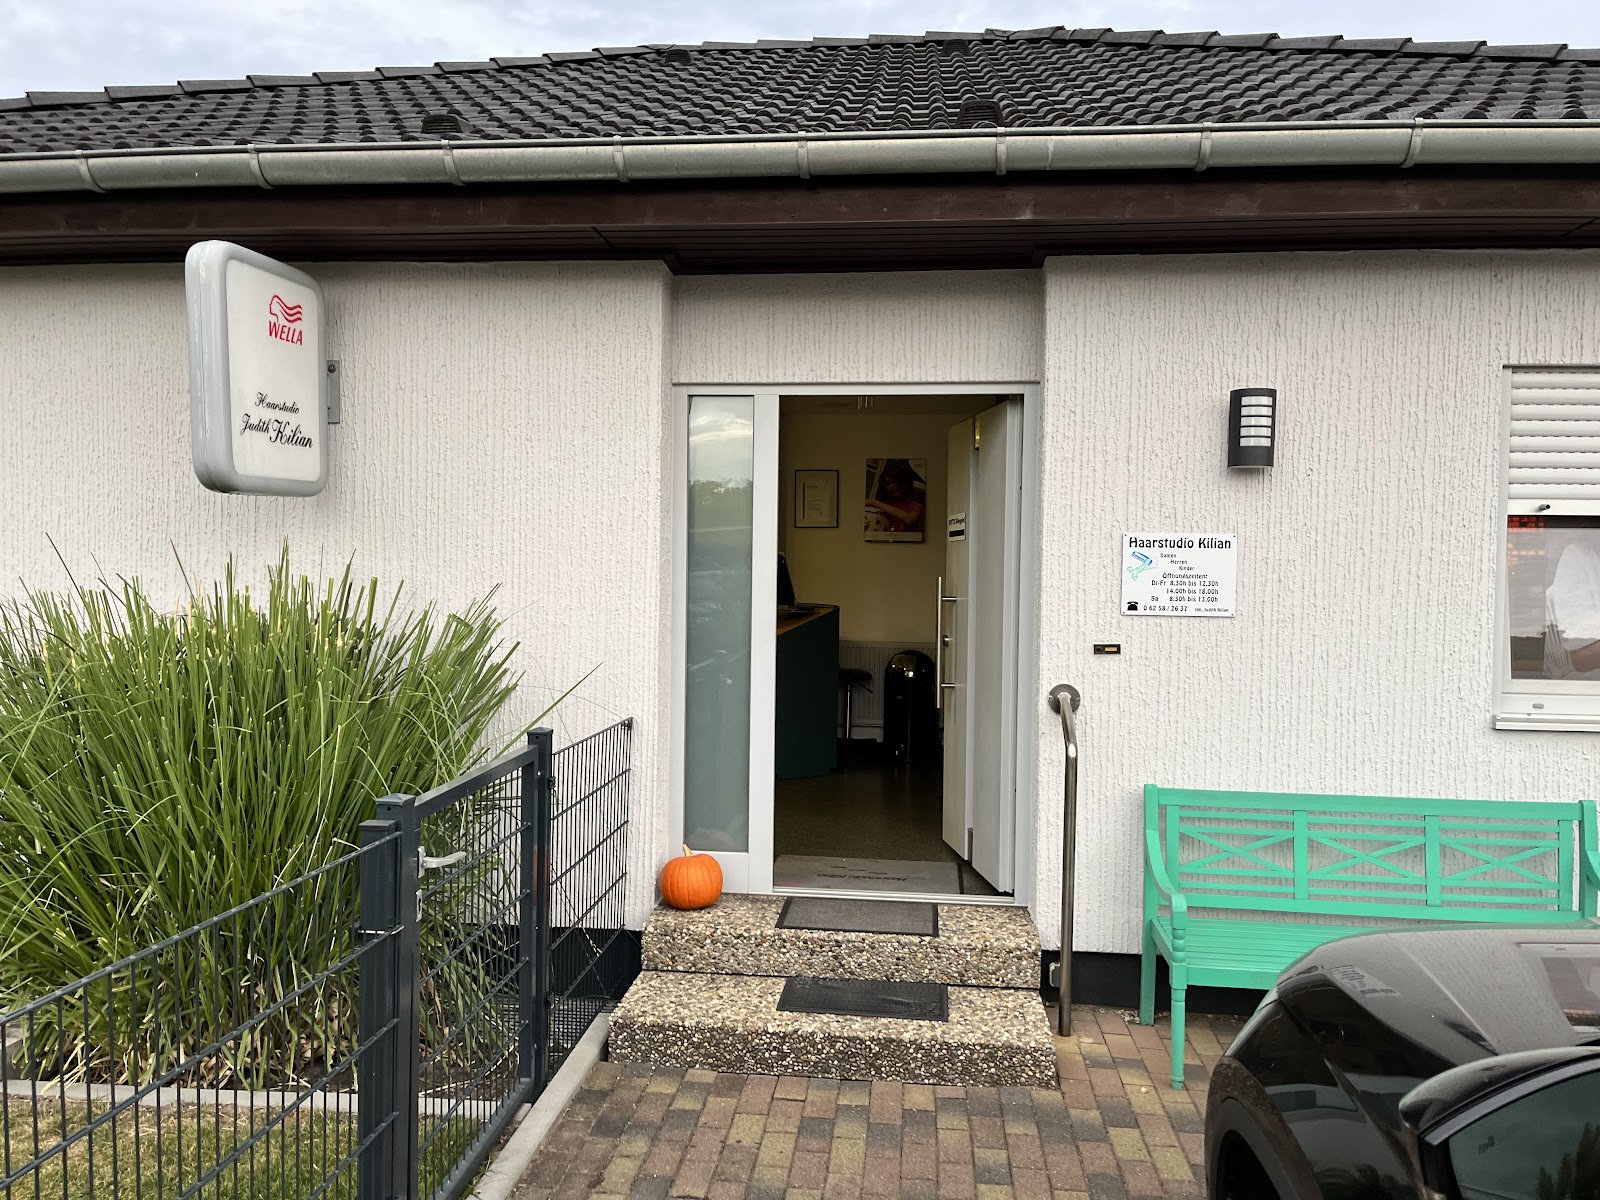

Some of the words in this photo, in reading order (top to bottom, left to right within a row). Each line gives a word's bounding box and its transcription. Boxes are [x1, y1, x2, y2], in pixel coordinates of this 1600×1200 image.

[268, 320, 303, 346] WELLA
[254, 392, 300, 414] Haarstudio
[240, 413, 271, 436] Judith
[269, 419, 313, 449] Kilian
[1129, 537, 1194, 549] Haarstudio
[1198, 537, 1231, 549] Kilian
